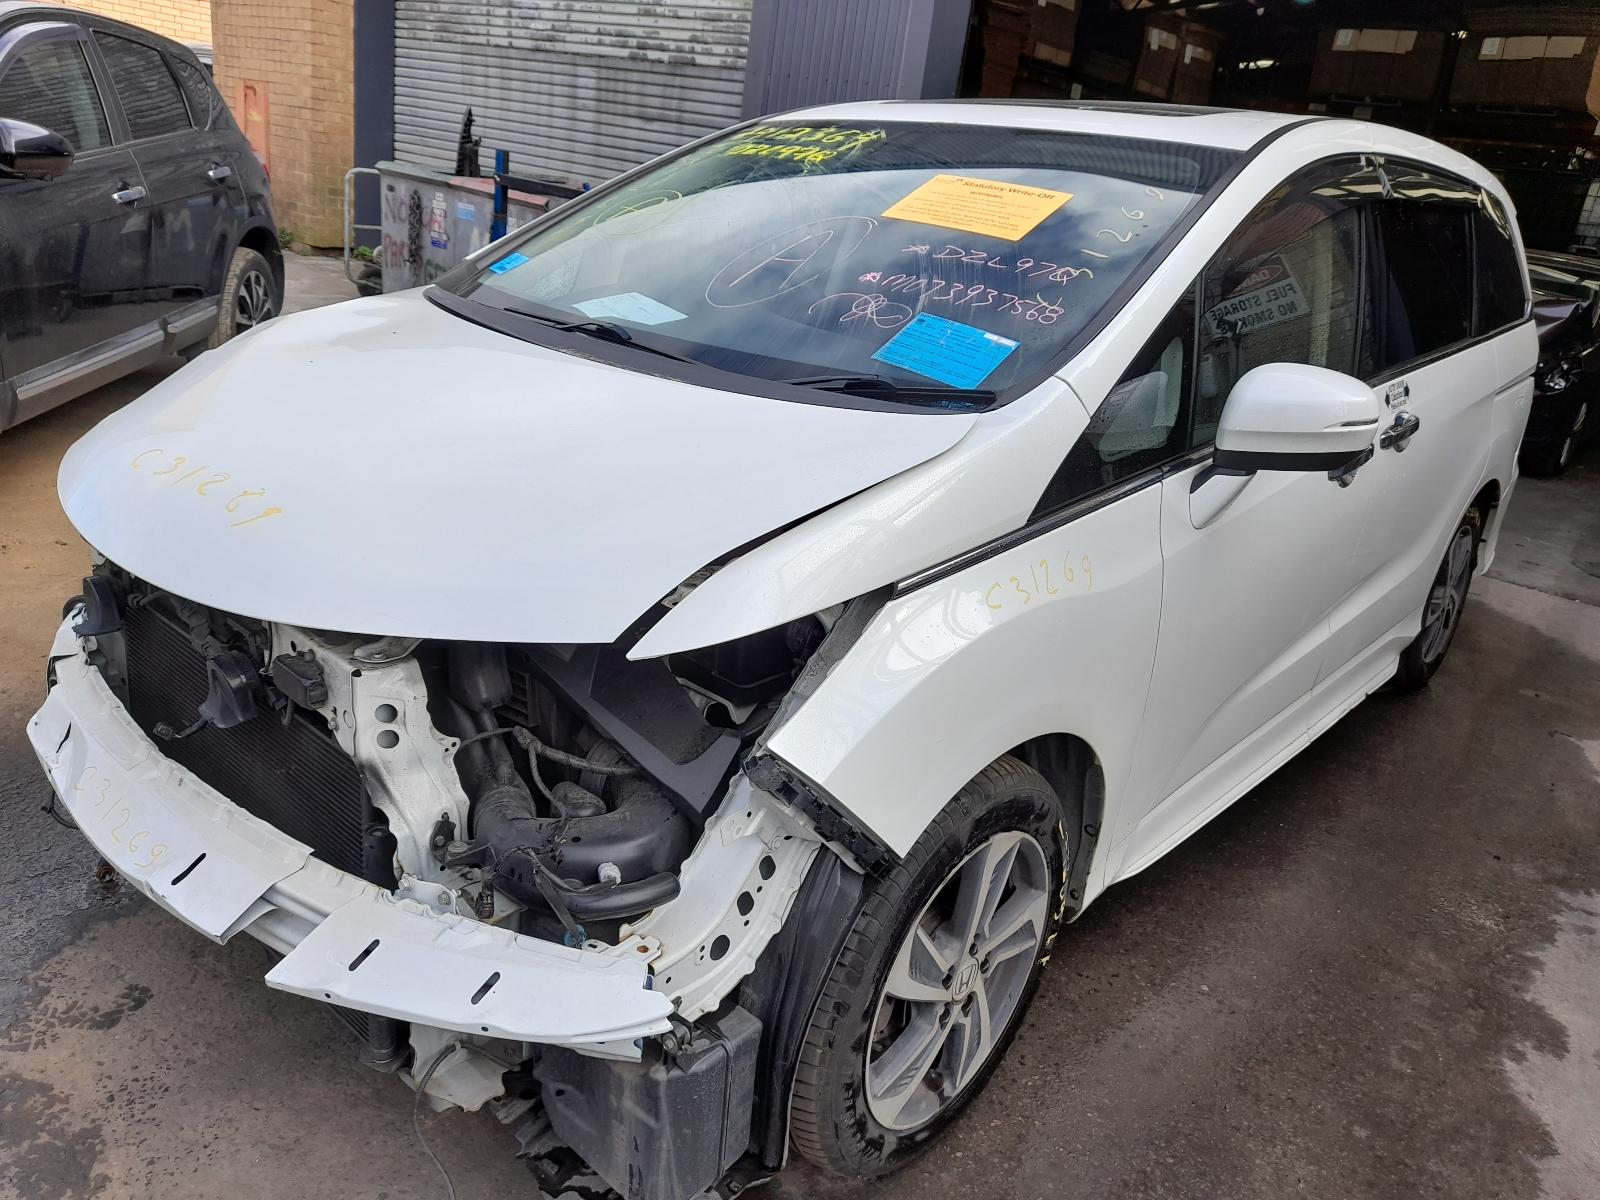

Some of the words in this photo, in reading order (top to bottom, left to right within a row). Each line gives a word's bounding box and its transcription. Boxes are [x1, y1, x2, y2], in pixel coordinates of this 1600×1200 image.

[963, 180, 1007, 192] Statutory
[1008, 186, 1056, 200] Write-Off
[985, 546, 1093, 609] C31269
[73, 766, 168, 868] C31269
